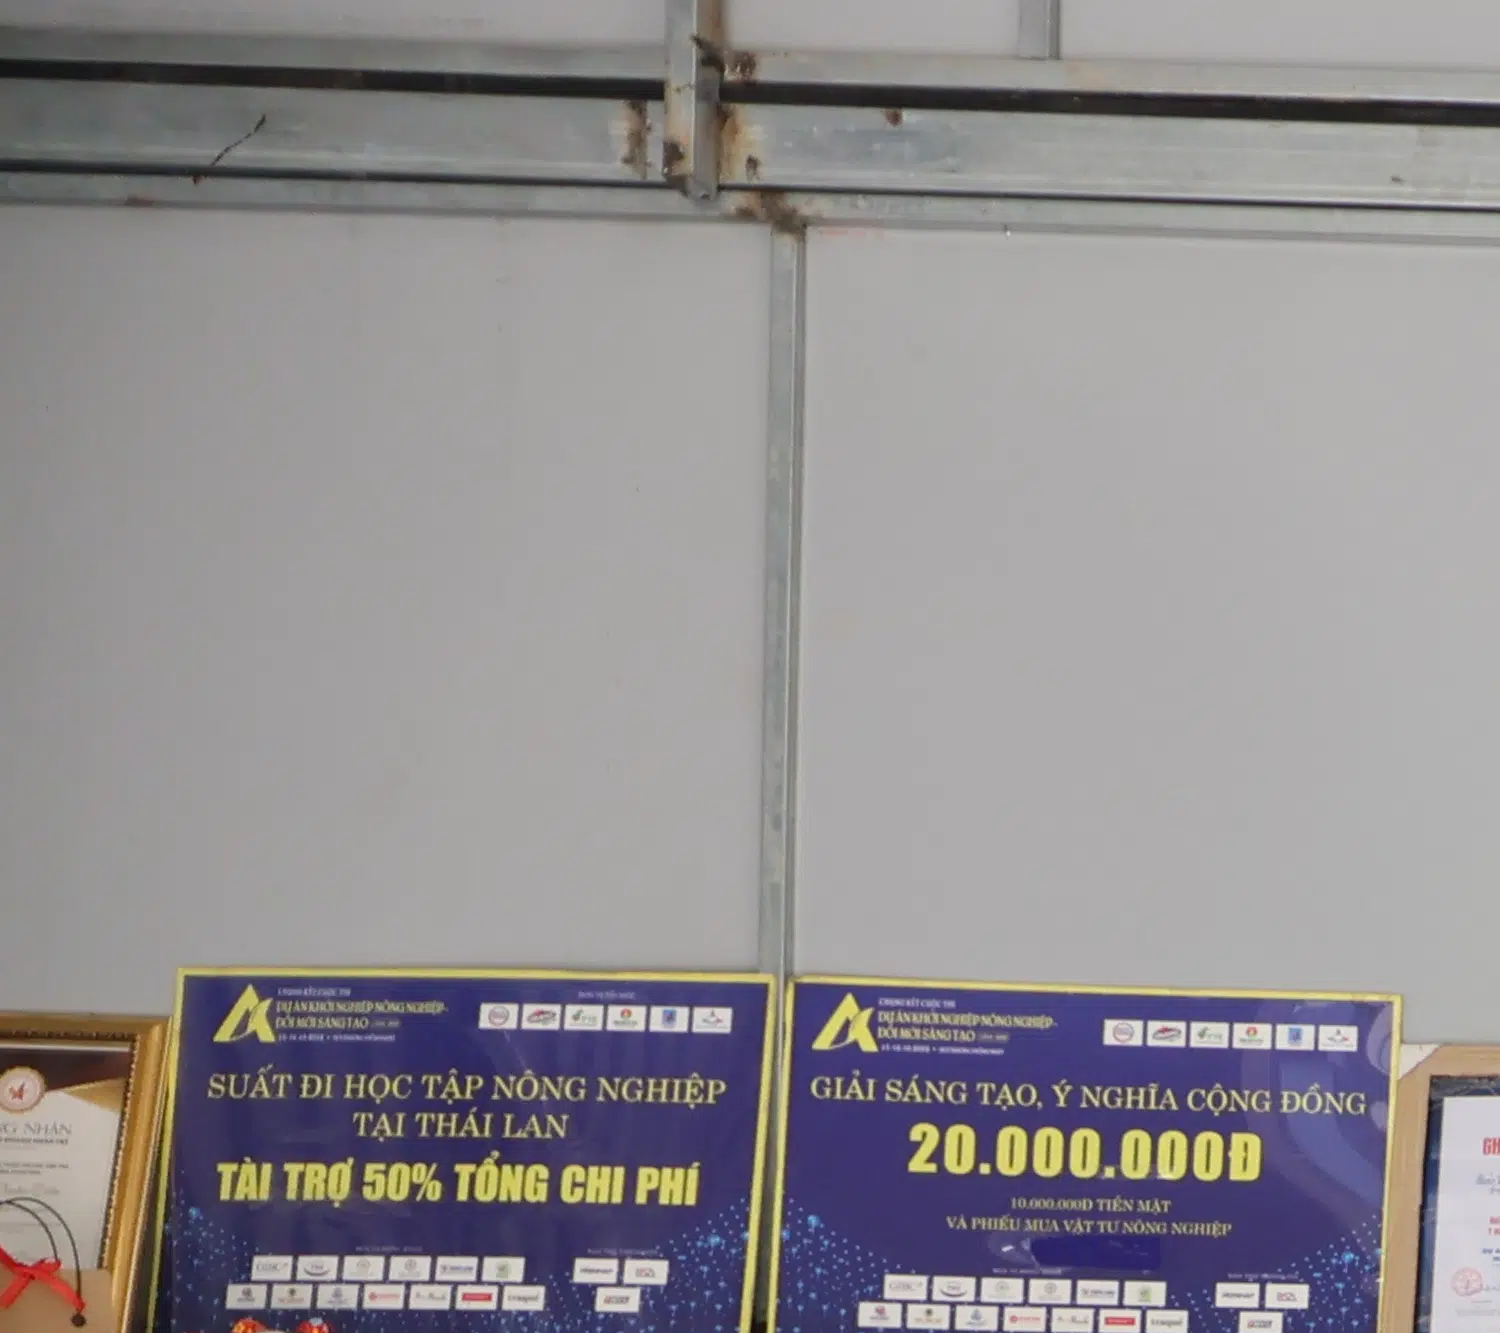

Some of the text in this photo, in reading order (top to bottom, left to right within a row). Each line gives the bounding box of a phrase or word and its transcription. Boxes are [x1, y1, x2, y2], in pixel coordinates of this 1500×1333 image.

[207, 1064, 726, 1110] SUẤT ĐI HỌC TẬP NÔNG NGHIỆP
[810, 1075, 1365, 1117] GIẢI SÁNG TẠO, Ý NGHĨA CỘNG ĐỒNG
[353, 1107, 569, 1142] TẠI THÁI LAN
[908, 1122, 1262, 1181] 20.000.000Đ
[217, 1150, 701, 1207] TÀI TRỢ 50% TỔNG CHI PHÍ
[946, 1214, 967, 1231] VÀ
[970, 1214, 1021, 1232] PHIẾU
[1024, 1219, 1060, 1232] MUA
[1063, 1217, 1094, 1235] VẬT
[1122, 1220, 1167, 1234] NÔNG
[1171, 1220, 1232, 1239] NGHIỆP
